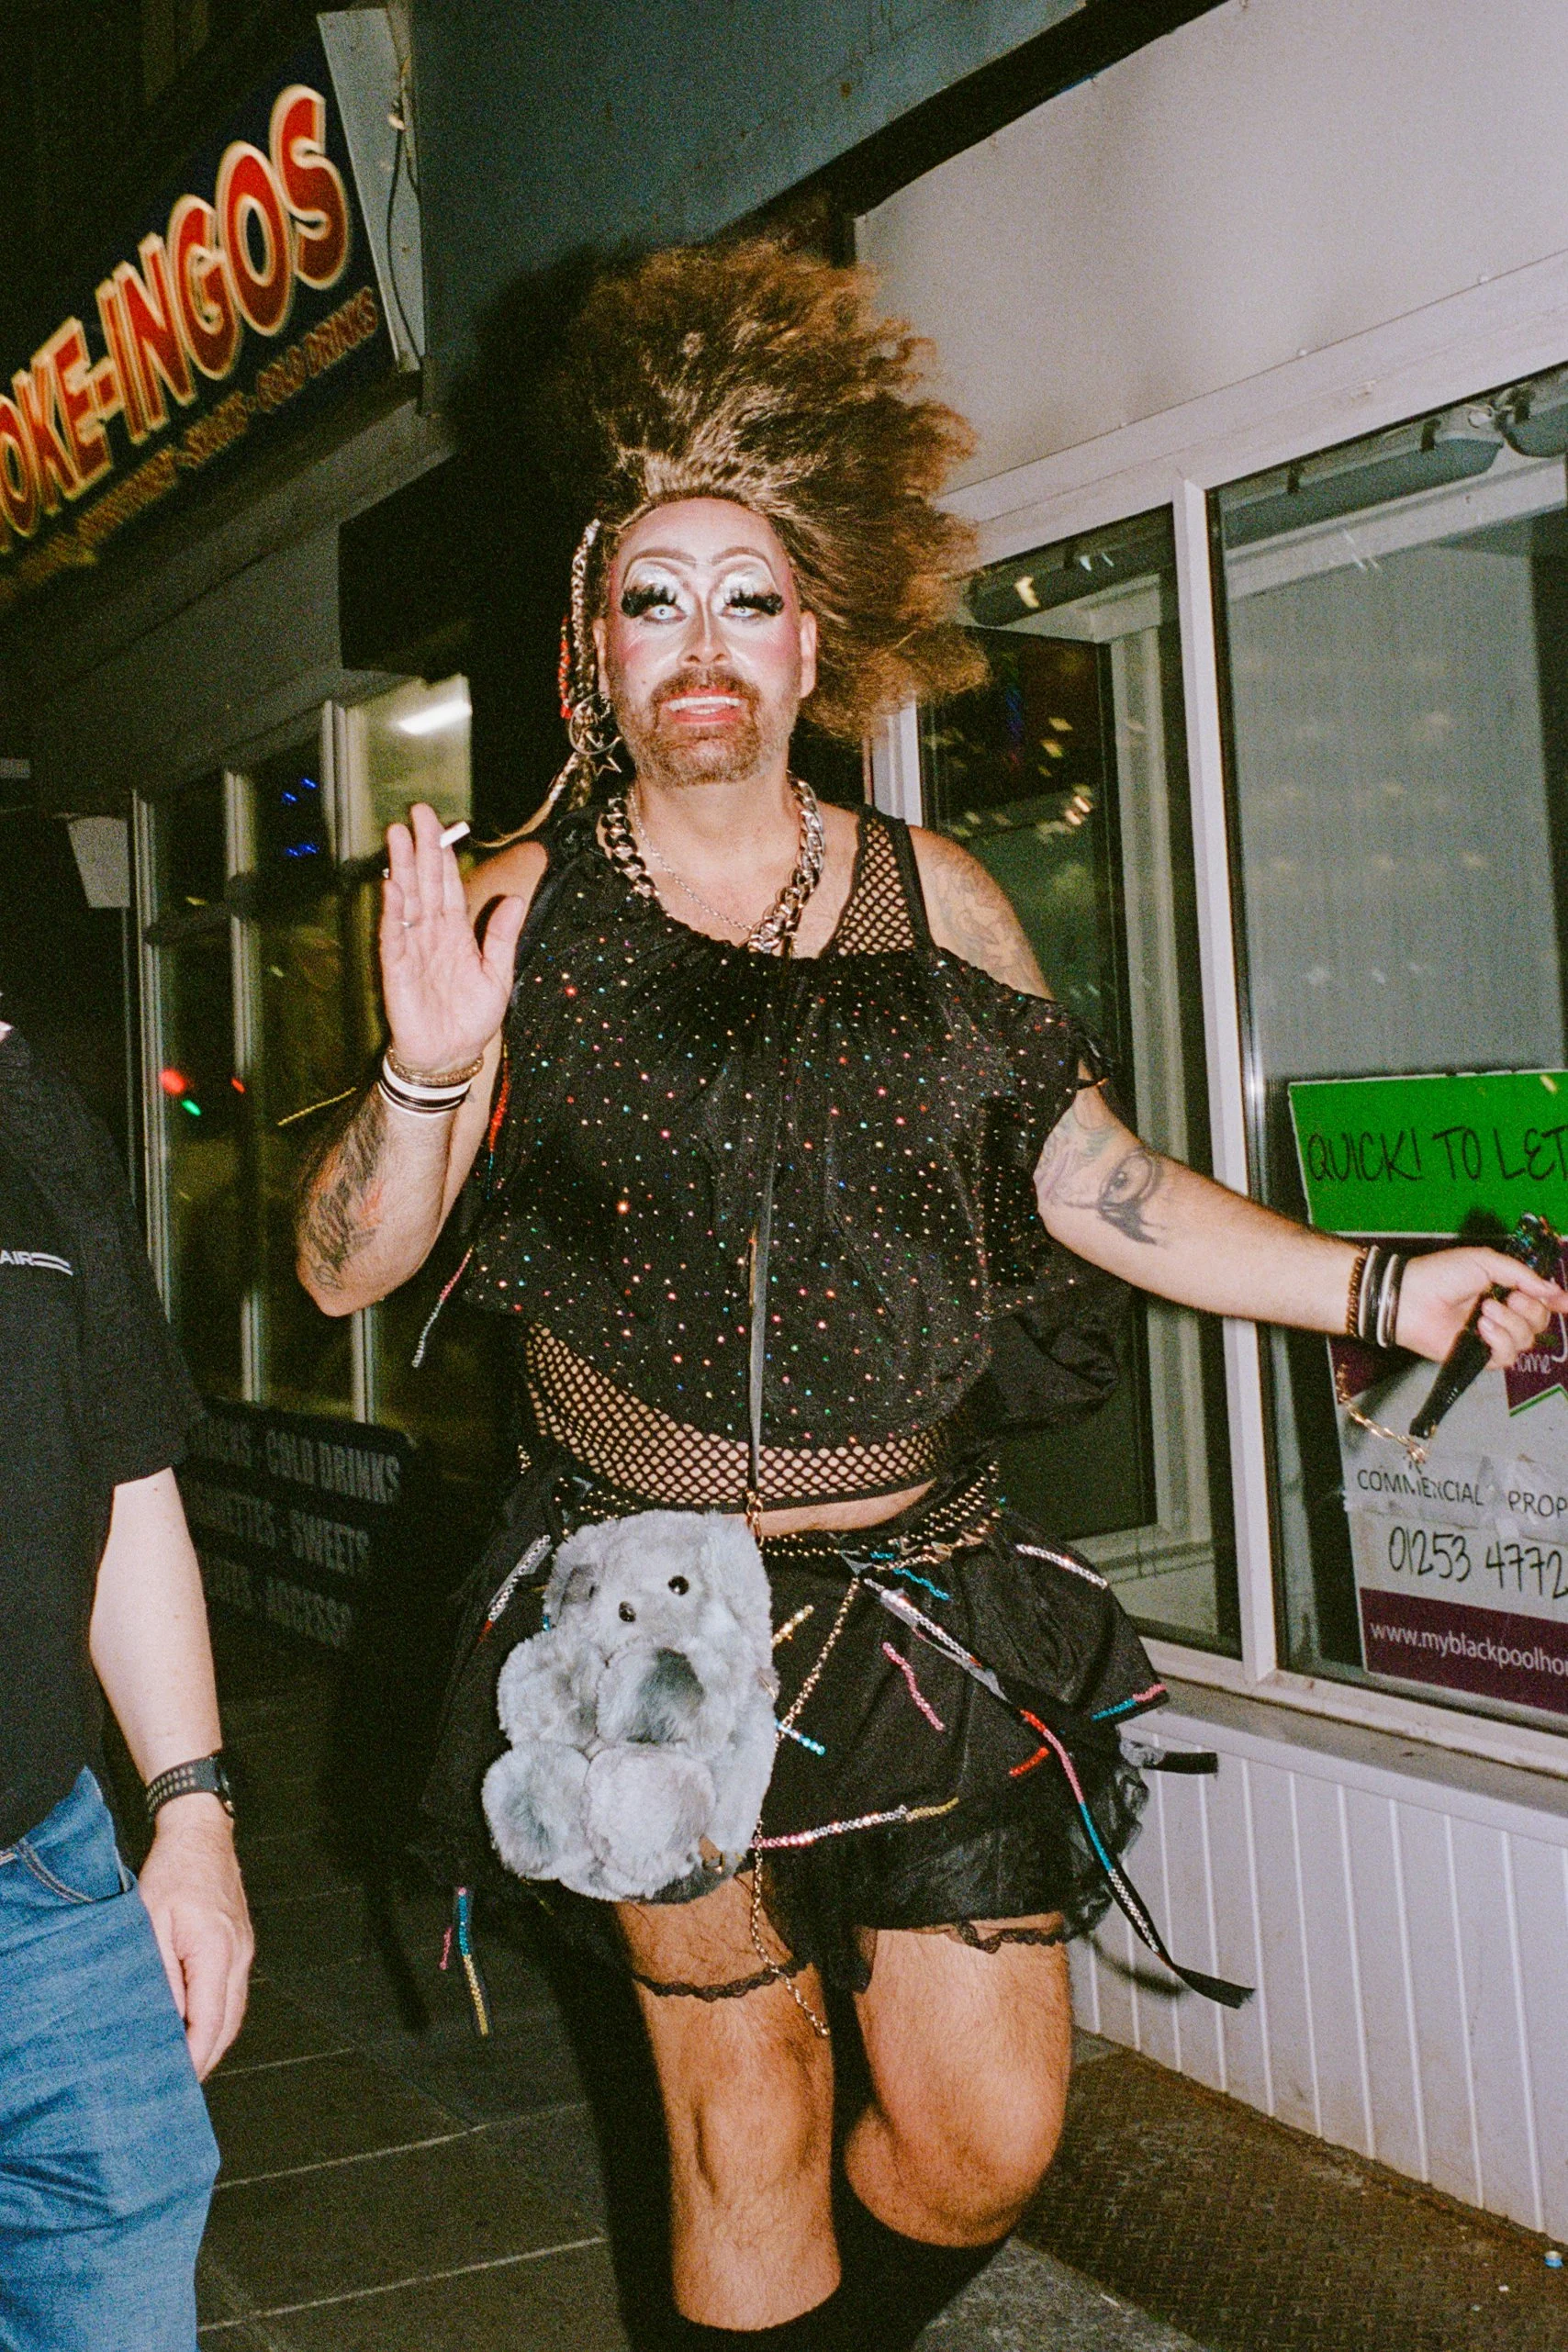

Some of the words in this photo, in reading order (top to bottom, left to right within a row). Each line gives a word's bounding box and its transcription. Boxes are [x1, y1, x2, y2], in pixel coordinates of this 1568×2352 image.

[0, 83, 351, 551] OKE-INGOS
[1432, 1126, 1483, 1181] TO
[1493, 1125, 1568, 1182] LET
[1511, 1351, 1552, 1374] ome
[319, 1440, 401, 1505] DRINKS
[1388, 1526, 1472, 1583] 01253
[1484, 1540, 1568, 1600] 4772
[1369, 1621, 1568, 1677] www.myblackpoolho
